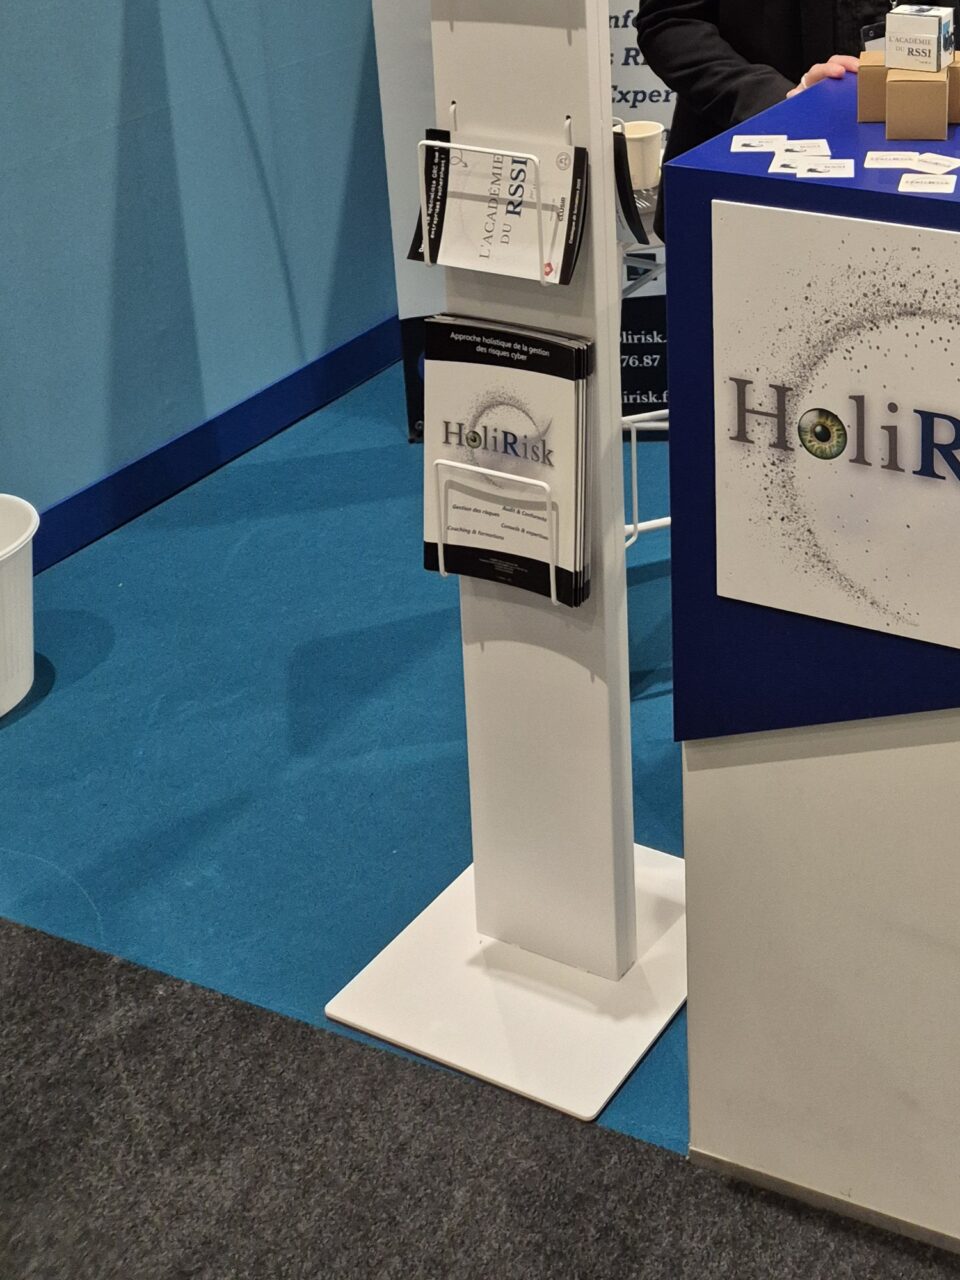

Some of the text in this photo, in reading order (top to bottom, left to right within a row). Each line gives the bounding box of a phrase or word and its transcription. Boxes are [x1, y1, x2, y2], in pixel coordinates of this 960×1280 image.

[907, 47, 932, 58] RSSI
[479, 153, 504, 260] L'ACADÉMIE
[500, 156, 528, 246] DU RSSI
[450, 331, 550, 357] Approche holistique de la gestion
[475, 345, 528, 361] des risques cyber
[442, 420, 555, 468] HoliRisk
